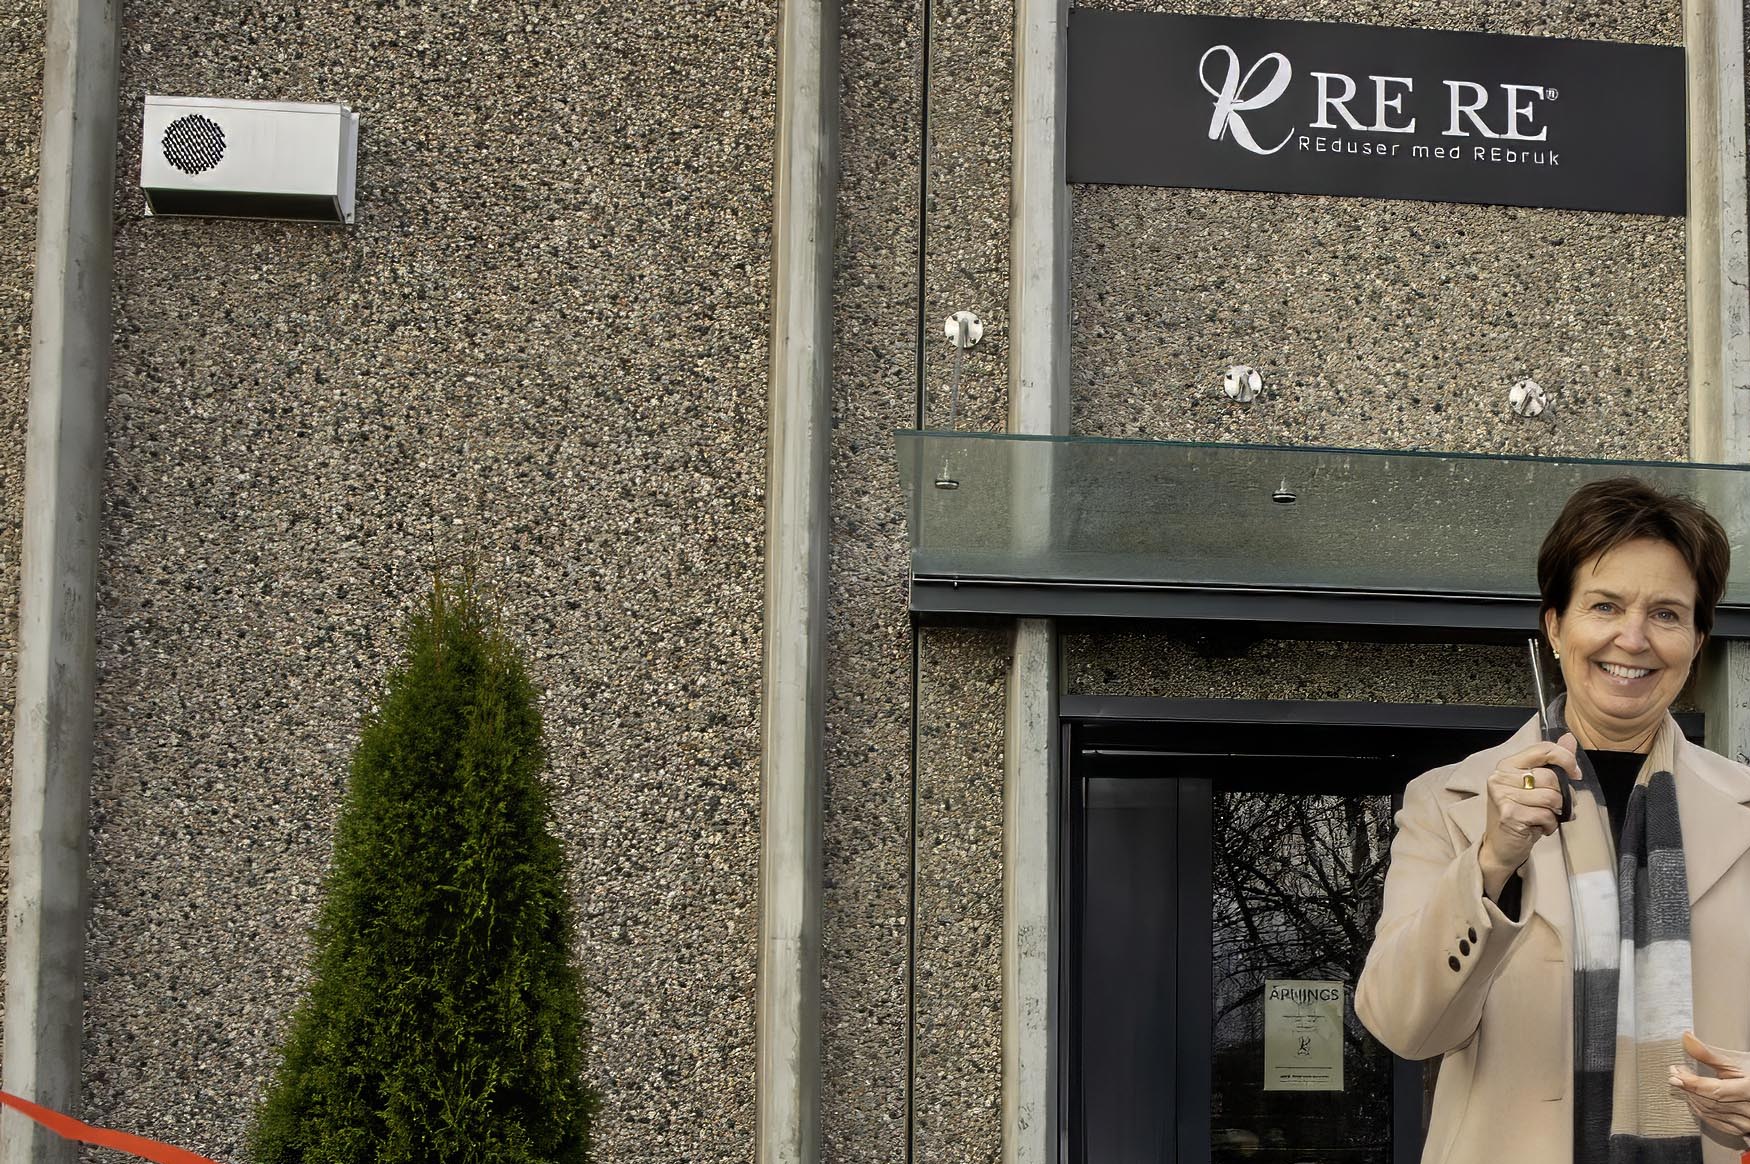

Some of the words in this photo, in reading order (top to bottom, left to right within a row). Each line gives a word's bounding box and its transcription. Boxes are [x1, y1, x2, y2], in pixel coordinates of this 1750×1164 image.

[1309, 71, 1416, 134] RE
[1299, 136, 1400, 156] REduser
[1412, 145, 1461, 159] med
[1474, 146, 1559, 165] REbruk
